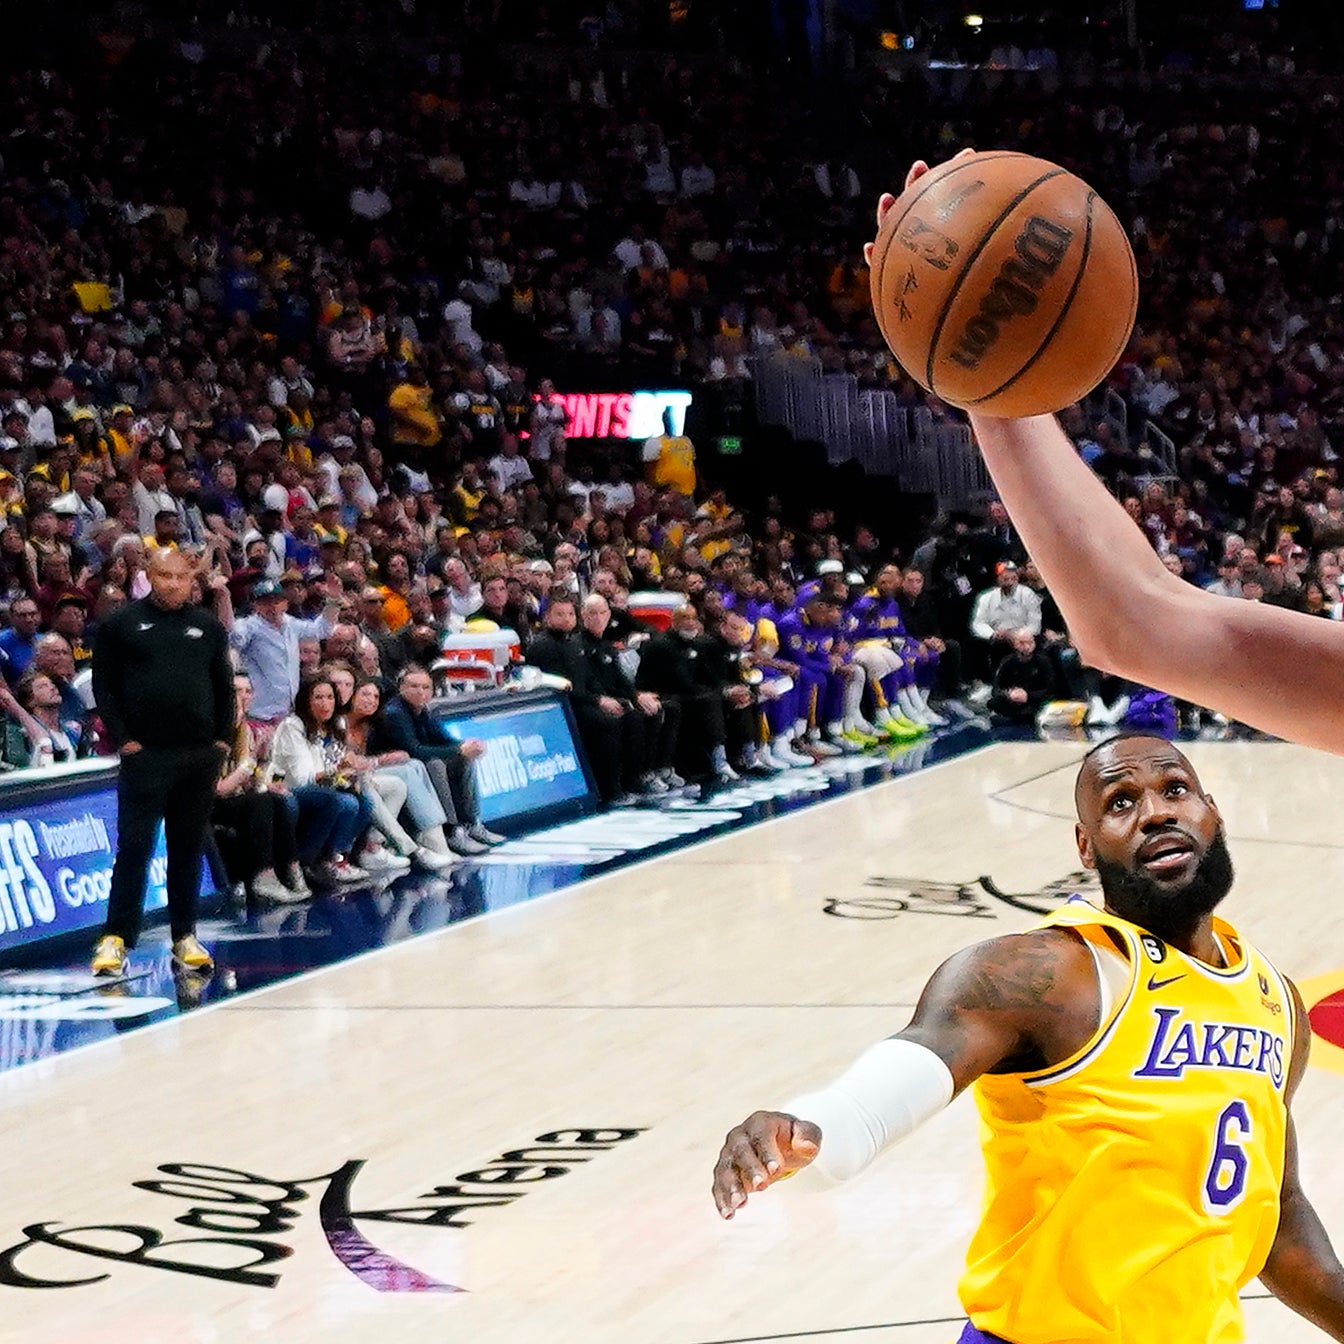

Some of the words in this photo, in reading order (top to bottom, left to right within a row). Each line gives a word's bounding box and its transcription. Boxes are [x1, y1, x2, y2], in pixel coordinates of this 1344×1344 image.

[1144, 938, 1162, 963] 6
[1134, 1007, 1284, 1089] LAKERS
[349, 1126, 652, 1228] Arena
[1203, 1099, 1252, 1213] 6
